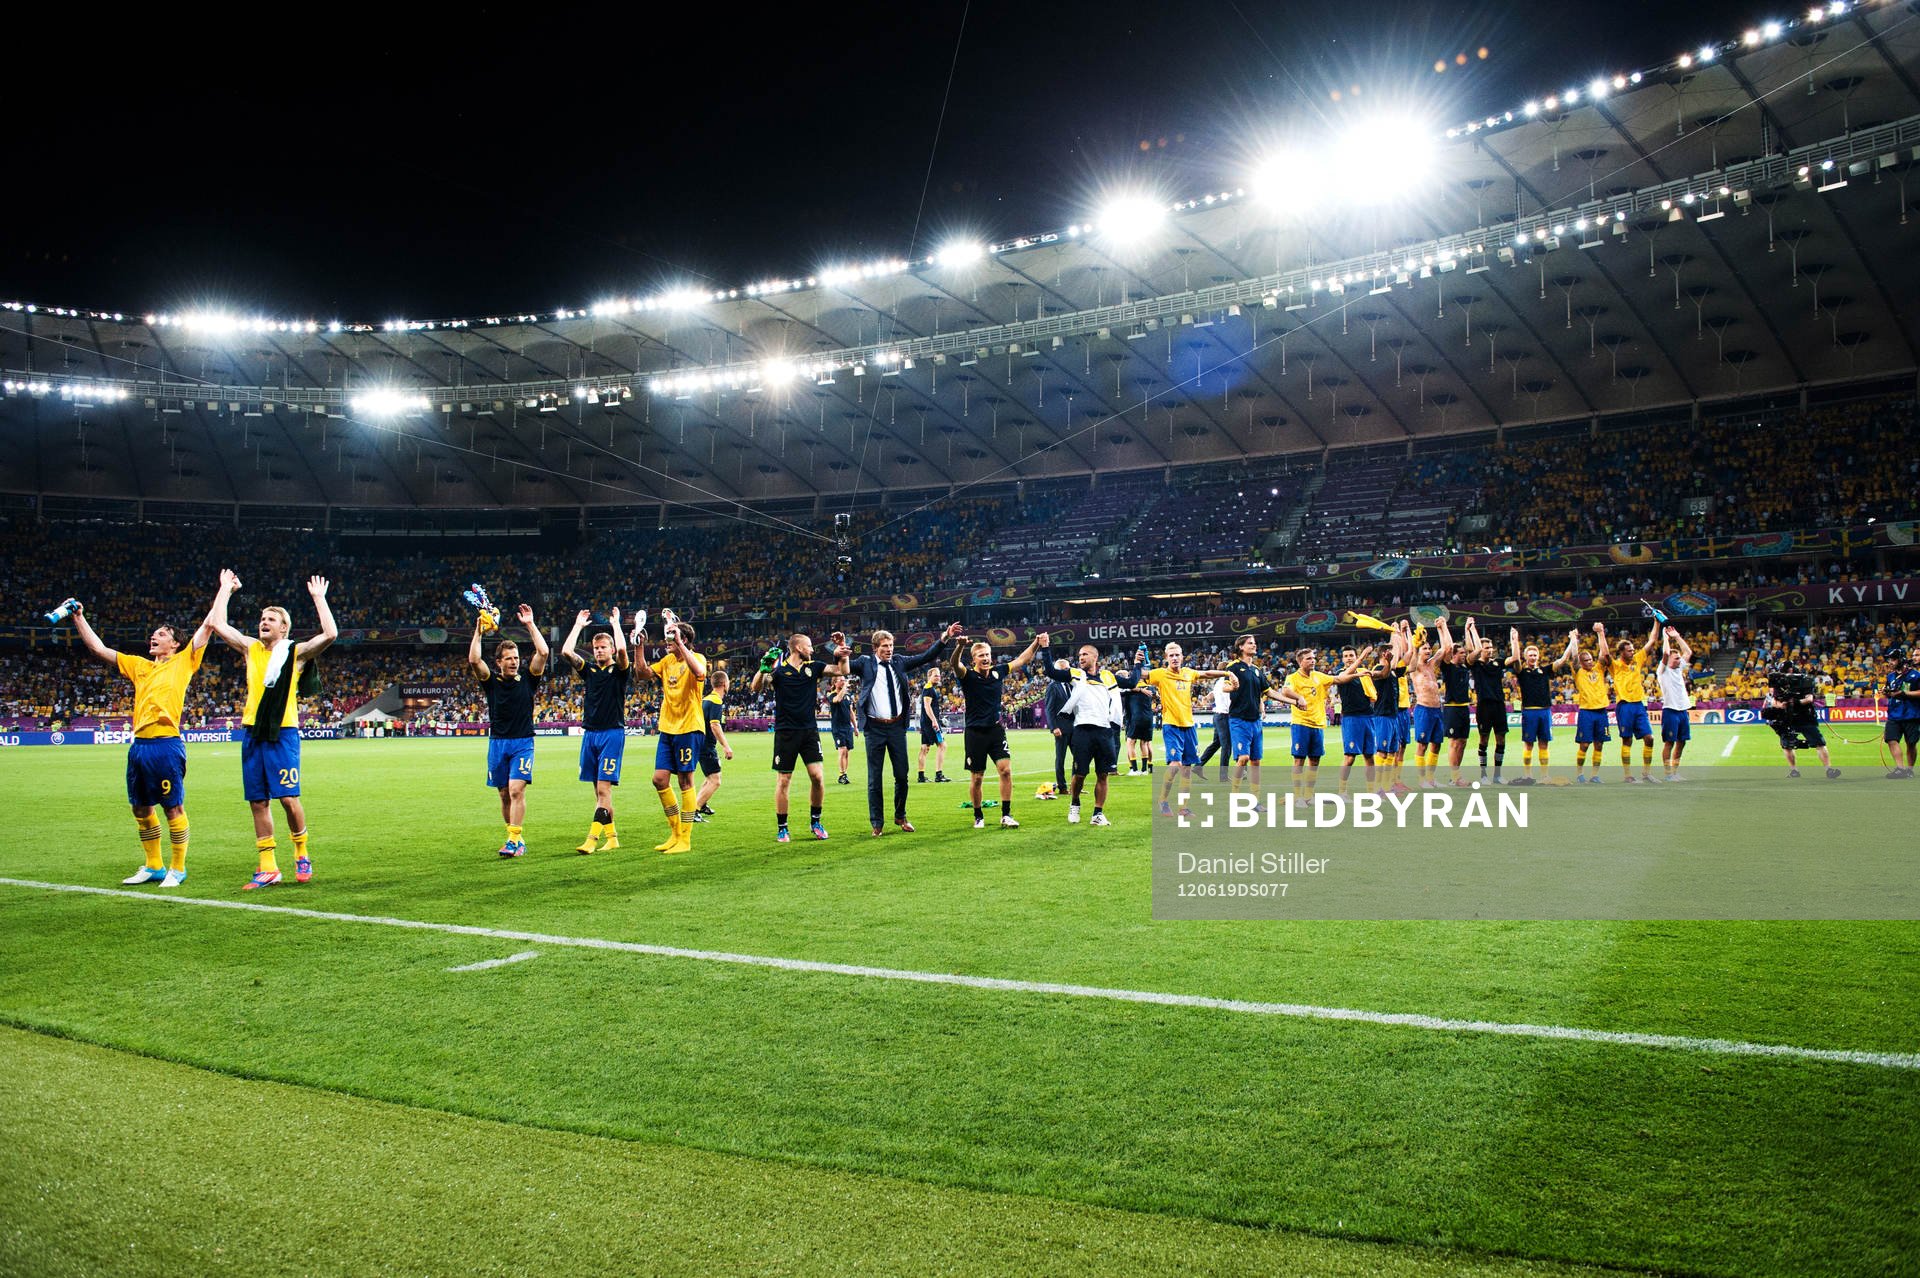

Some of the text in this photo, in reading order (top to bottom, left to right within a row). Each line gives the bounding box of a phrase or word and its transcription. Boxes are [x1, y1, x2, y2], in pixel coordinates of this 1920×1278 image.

[1471, 519, 1487, 528] 70
[1829, 583, 1908, 604] KYIV
[1088, 621, 1214, 639] UEFA EURO 2012
[187, 731, 232, 742] DIVERSITÉ
[680, 747, 692, 762] 13
[518, 758, 532, 771] 14
[602, 758, 616, 772] 15
[279, 767, 299, 785] 20
[161, 779, 171, 795] 9
